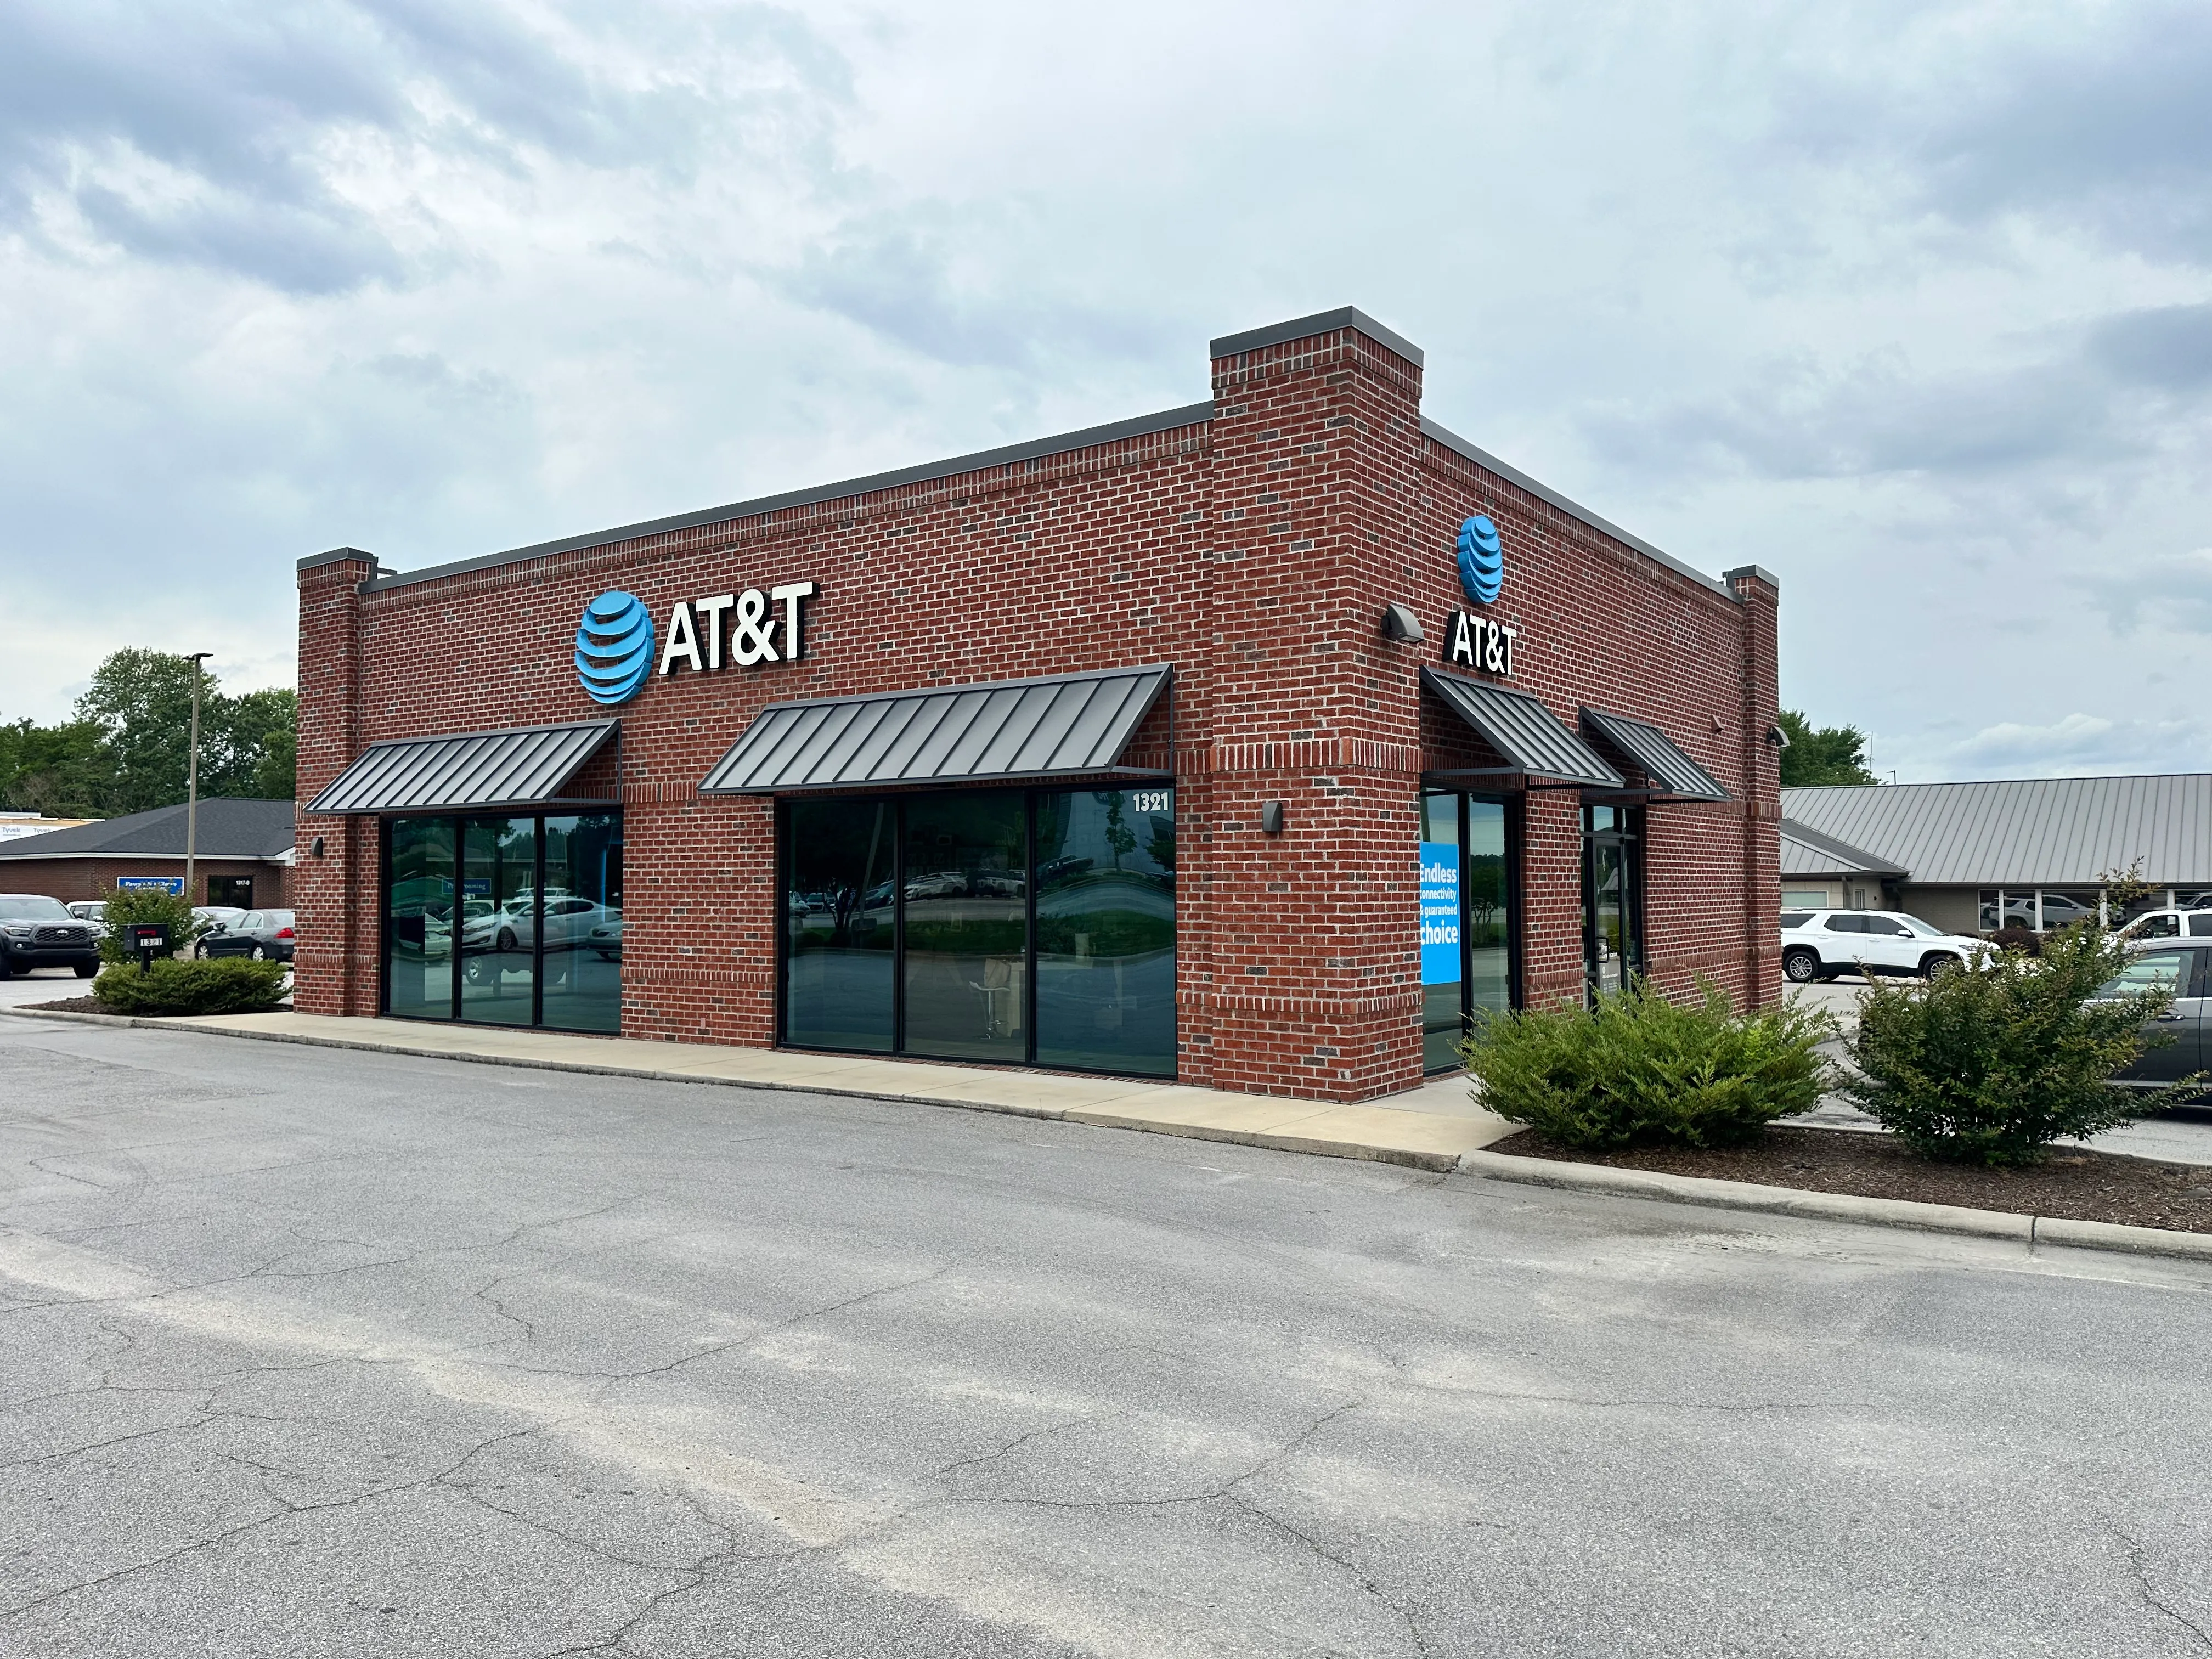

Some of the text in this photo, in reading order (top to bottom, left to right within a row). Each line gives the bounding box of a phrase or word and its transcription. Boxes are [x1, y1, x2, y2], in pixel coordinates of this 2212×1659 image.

[659, 581, 819, 675] AT&T
[1448, 611, 1517, 675] AT&T
[1133, 792, 1168, 811] 1321
[1420, 862, 1457, 883] Endless
[1424, 904, 1458, 918] guaranteed
[1420, 919, 1458, 945] choice
